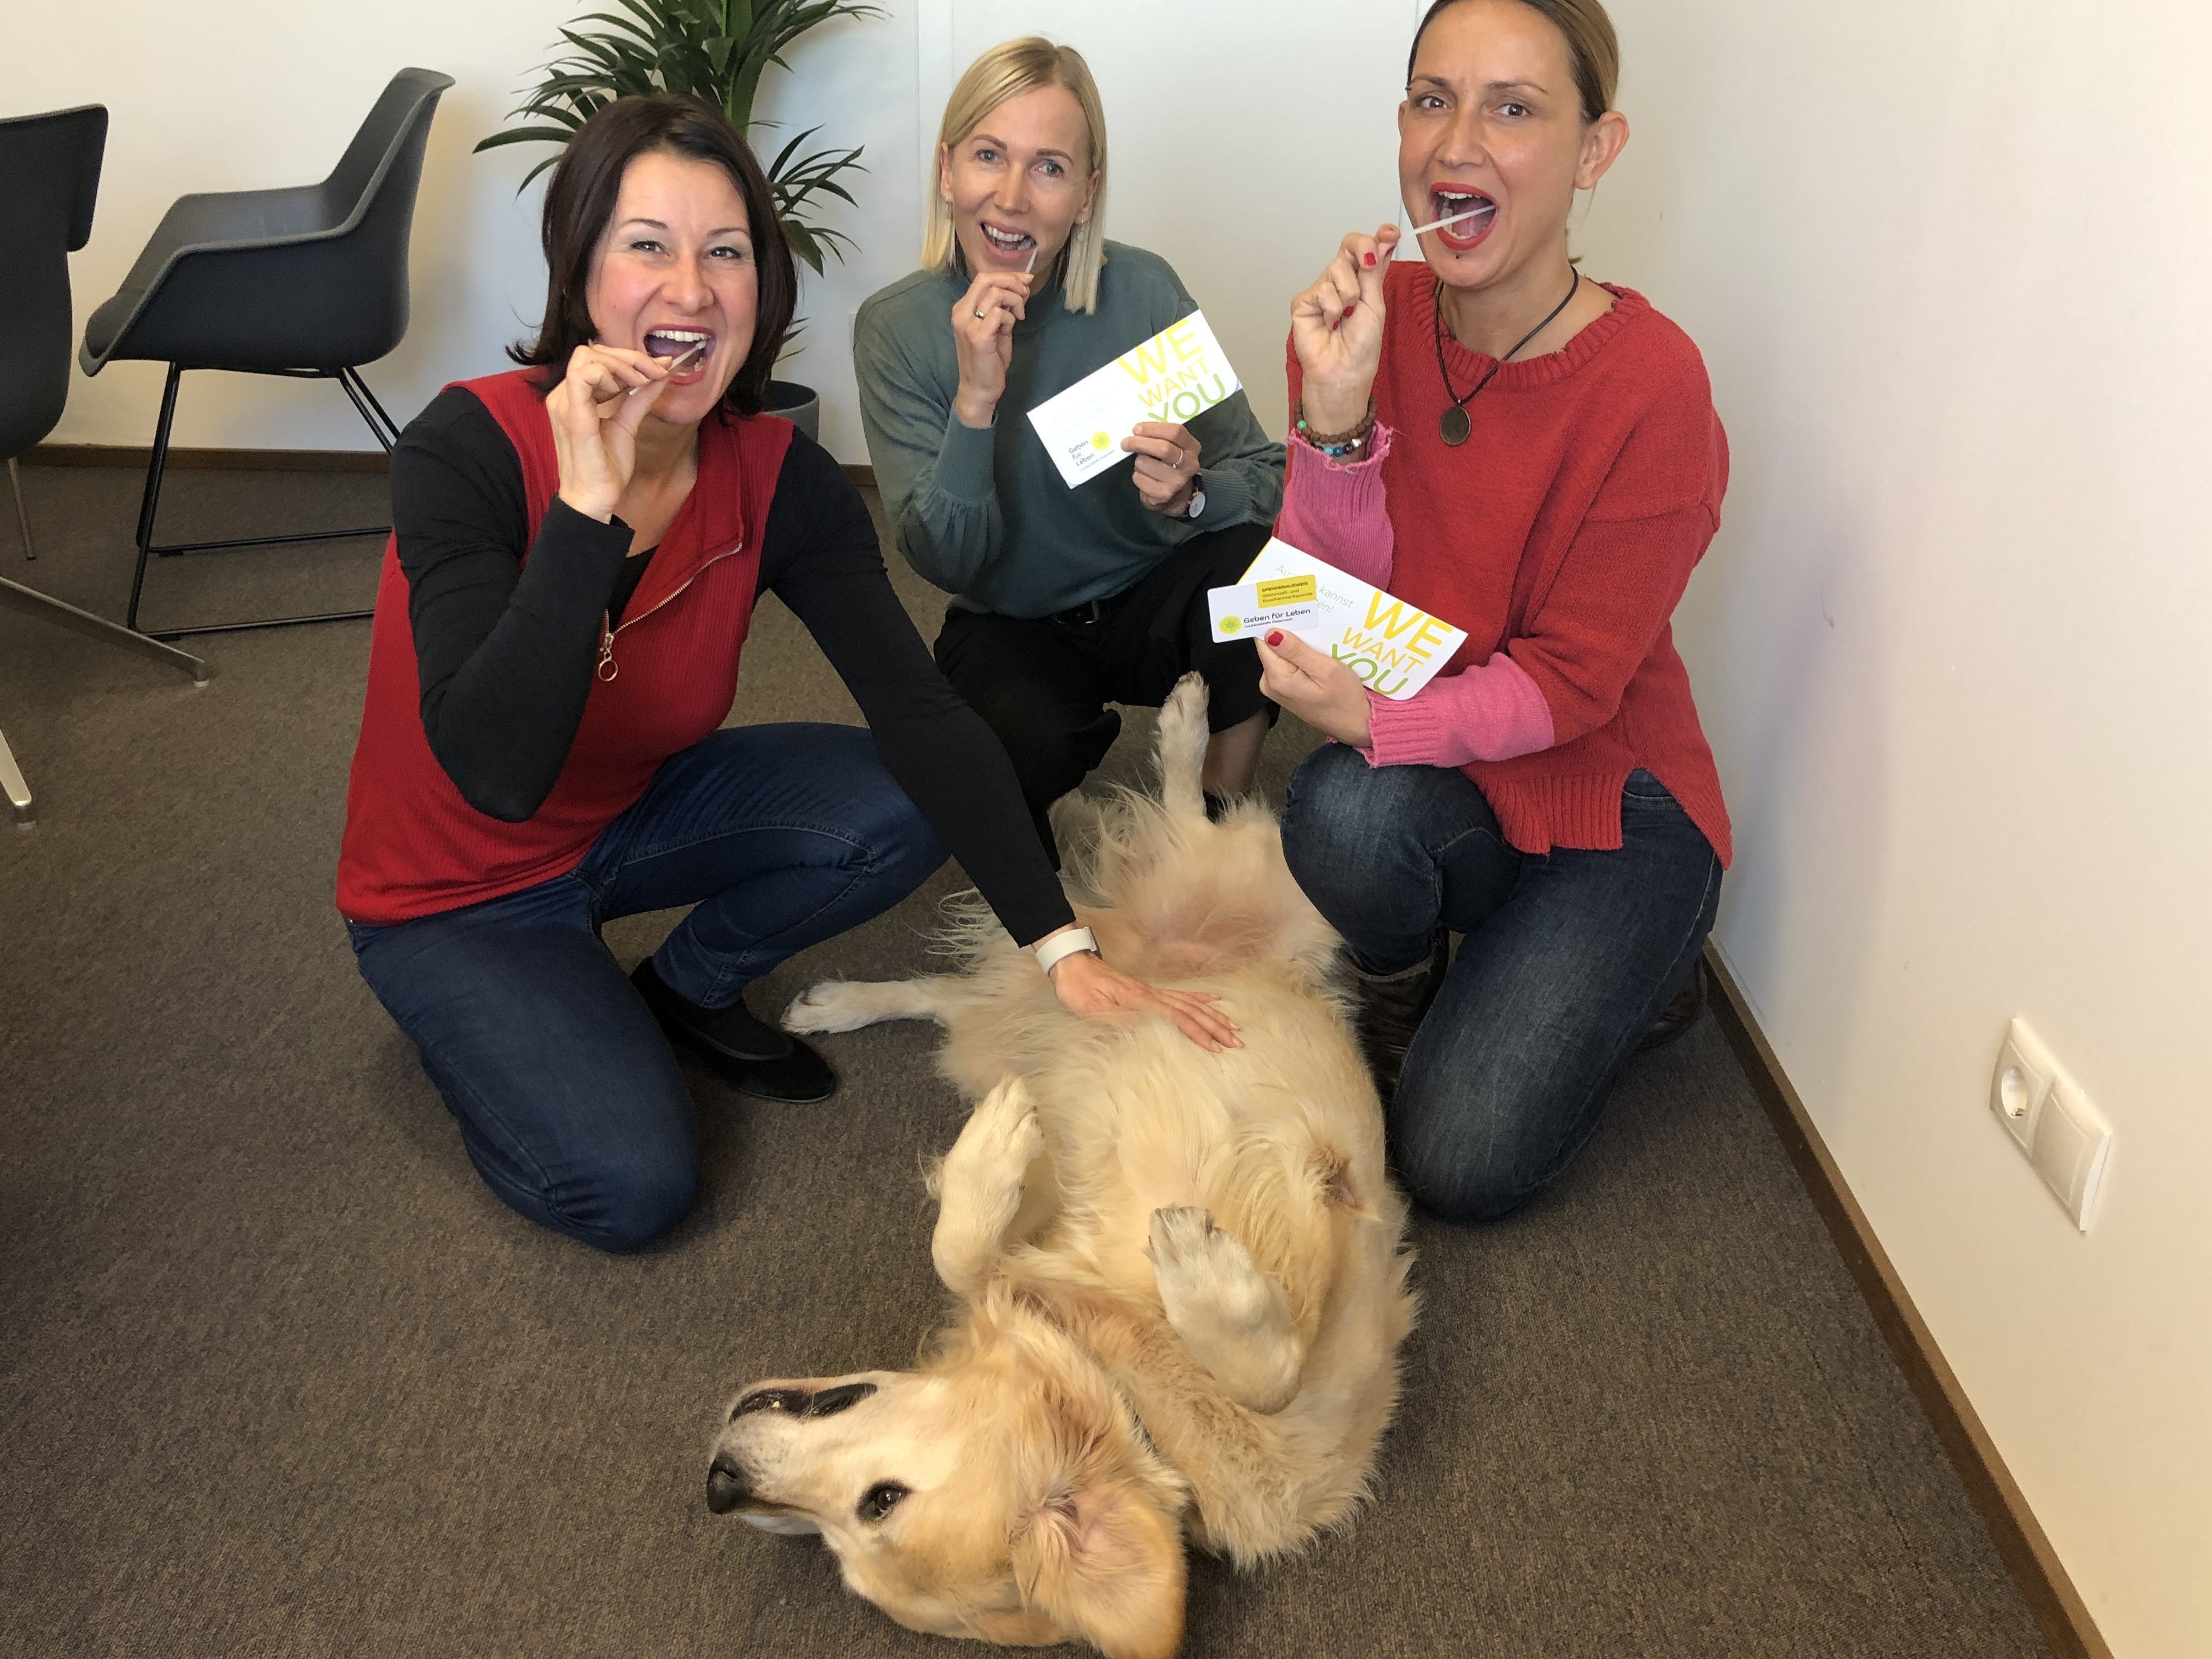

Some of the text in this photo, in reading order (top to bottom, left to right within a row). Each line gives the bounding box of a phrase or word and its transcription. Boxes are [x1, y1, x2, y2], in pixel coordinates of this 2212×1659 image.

[1117, 317, 1204, 385] WE
[1137, 357, 1210, 408] WANT
[1148, 374, 1226, 423] YOU
[1243, 615, 1270, 624] Geben
[1286, 609, 1311, 617] Leben
[1319, 585, 1354, 609] kannst
[1363, 590, 1454, 659] WE
[1331, 643, 1409, 695] YOU
[1342, 627, 1424, 674] WANT
